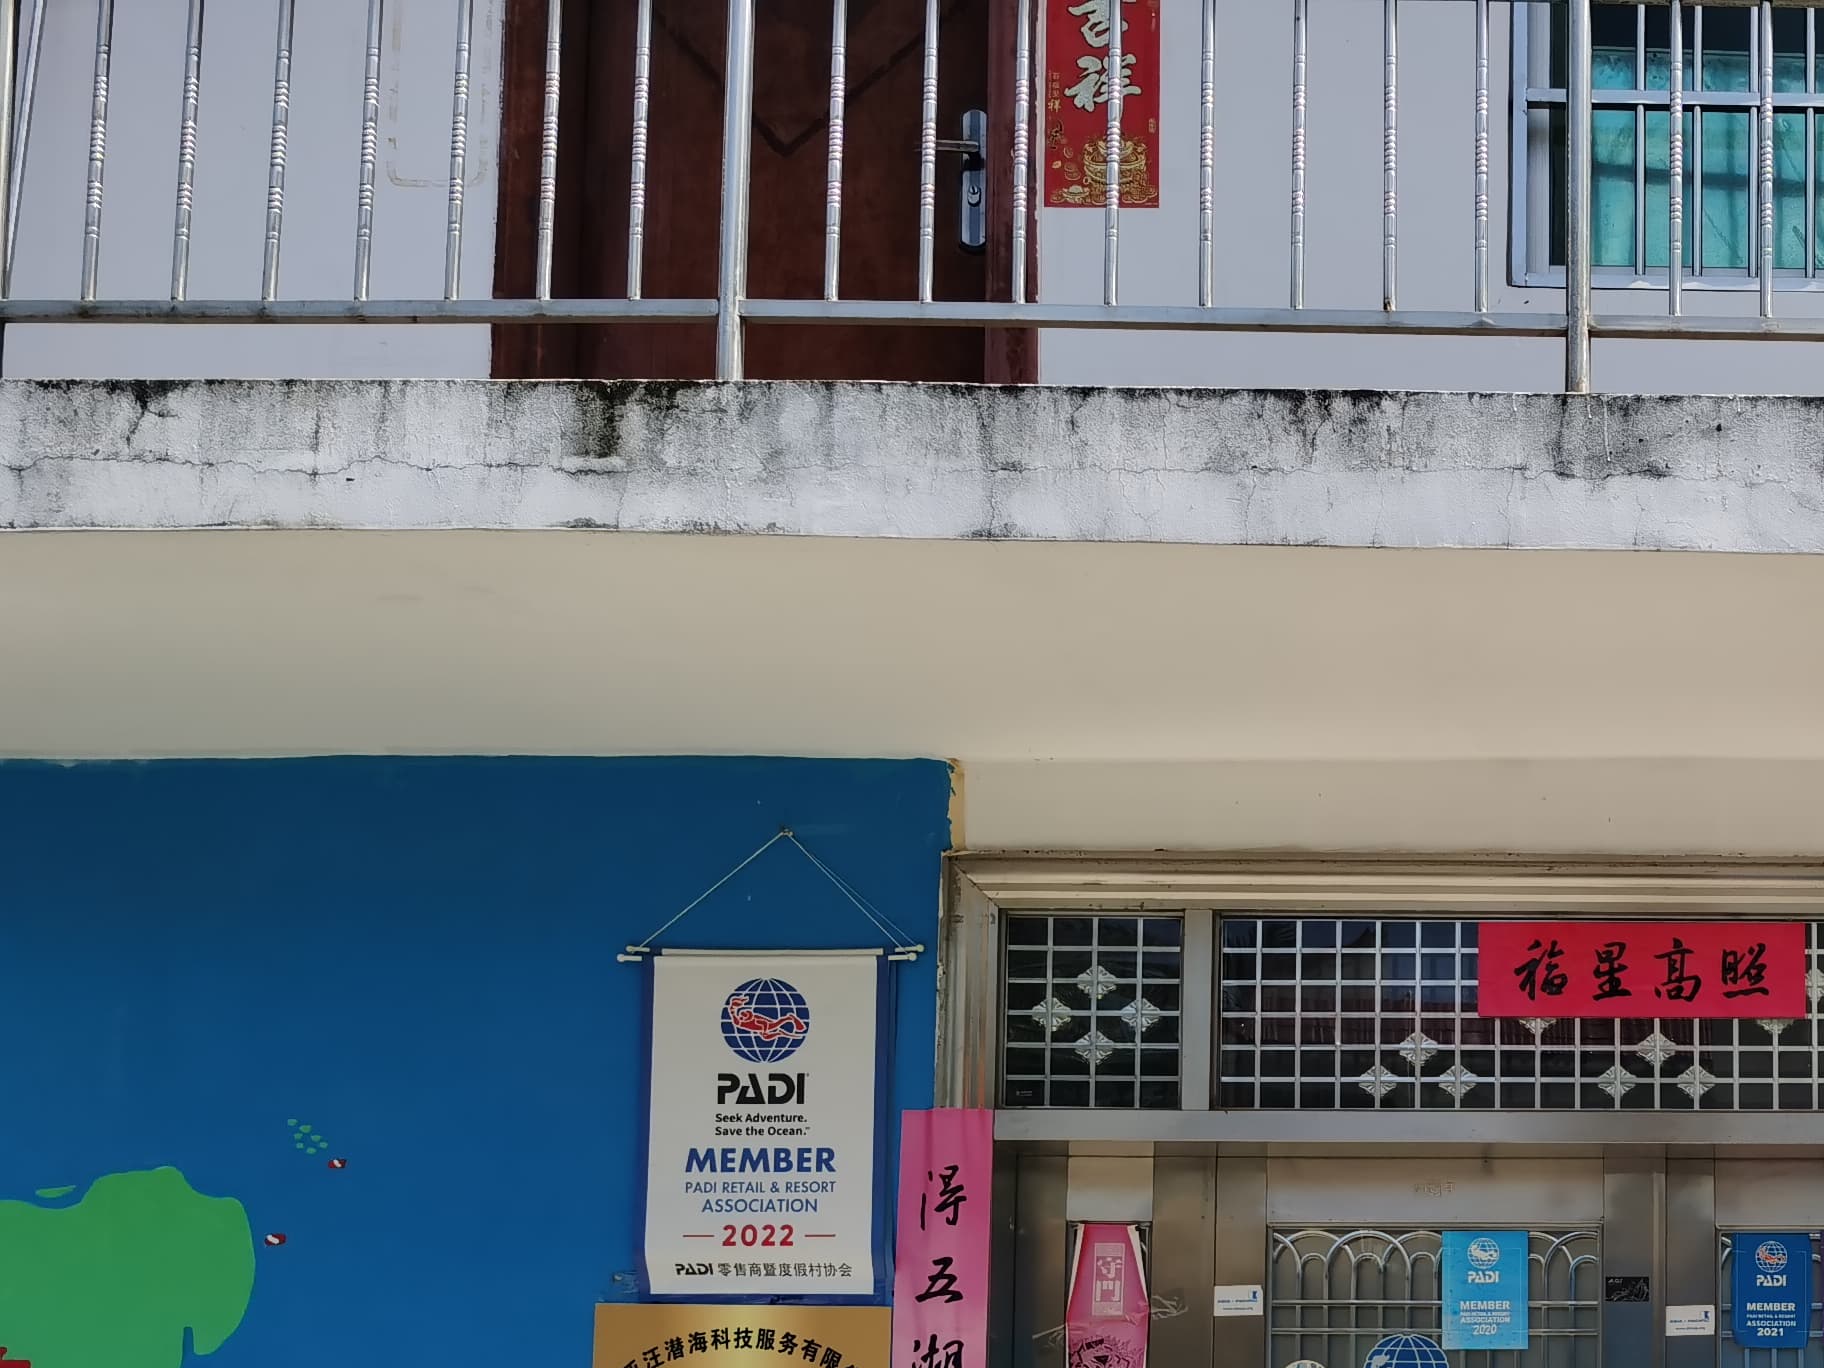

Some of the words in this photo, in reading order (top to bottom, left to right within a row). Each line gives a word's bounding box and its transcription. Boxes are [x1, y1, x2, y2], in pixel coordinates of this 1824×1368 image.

[1514, 937, 1770, 1001] 福星高照
[718, 1073, 806, 1105] PADI
[715, 1113, 743, 1123] Seek
[745, 1113, 808, 1123] Adventure.
[715, 1126, 743, 1136] Save
[745, 1126, 765, 1136] the
[685, 1147, 837, 1173] MEMBER
[685, 1181, 718, 1194] PADI
[722, 1181, 766, 1194] RETAIL
[769, 1181, 781, 1194] &
[785, 1181, 837, 1194] RESORT
[701, 1198, 818, 1213] ASSOCIATION
[722, 1224, 795, 1247] 2022
[674, 1264, 714, 1276] PADI
[717, 1262, 853, 1278] 零售商暨度假村协会
[1467, 1271, 1500, 1284] PADI
[1756, 1275, 1787, 1287] PADI
[1460, 1300, 1511, 1310] MEMBER
[1746, 1302, 1796, 1311] MEMBER
[1472, 1324, 1497, 1336] 2020
[1746, 1320, 1797, 1328] ASSOCIATION
[1757, 1327, 1784, 1337] 2021
